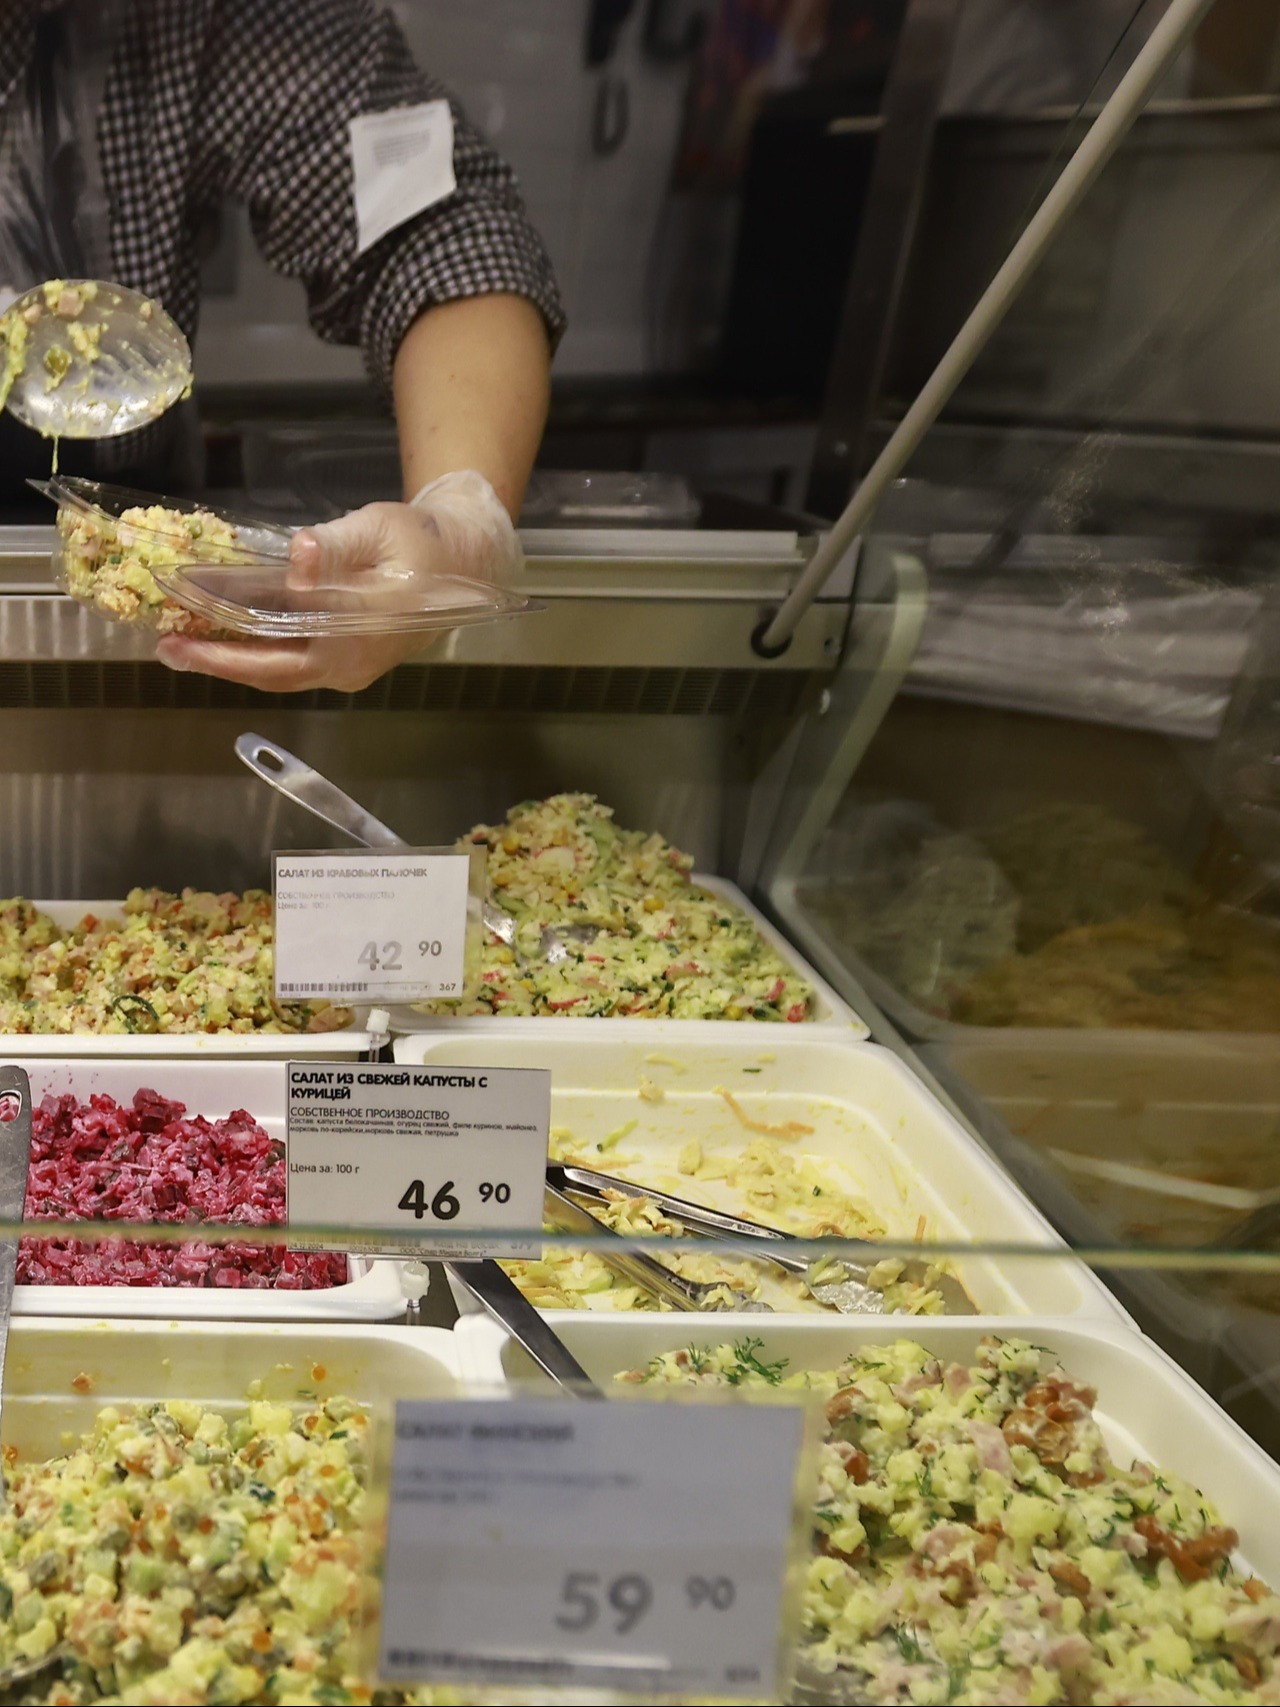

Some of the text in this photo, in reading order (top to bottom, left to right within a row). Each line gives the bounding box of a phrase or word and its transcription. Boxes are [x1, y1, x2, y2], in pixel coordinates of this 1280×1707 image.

[278, 868, 310, 878] САЛАТ
[311, 868, 325, 878] ИЗ
[327, 868, 380, 878] КРАБОВЫХ
[357, 940, 403, 971] 42
[418, 940, 443, 956] 90
[439, 983, 456, 991] 367
[291, 1072, 488, 1088] САЛАТ ИЗ СВЕЖЕЙ КАПУСТЫ С
[291, 1086, 351, 1101] КУРИЦЕЙ
[290, 1106, 450, 1121] СОБСТВЕННОЕ ПРОИЗВОДСТВО
[396, 1120, 421, 1129] огурец
[424, 1129, 459, 1138] петрушка
[290, 1163, 317, 1174] Цена
[319, 1165, 333, 1173] за:
[336, 1164, 352, 1174] 100
[398, 1179, 460, 1220] 46
[478, 1182, 511, 1204] 90
[685, 1573, 737, 1612] 90
[553, 1568, 654, 1635] 59
